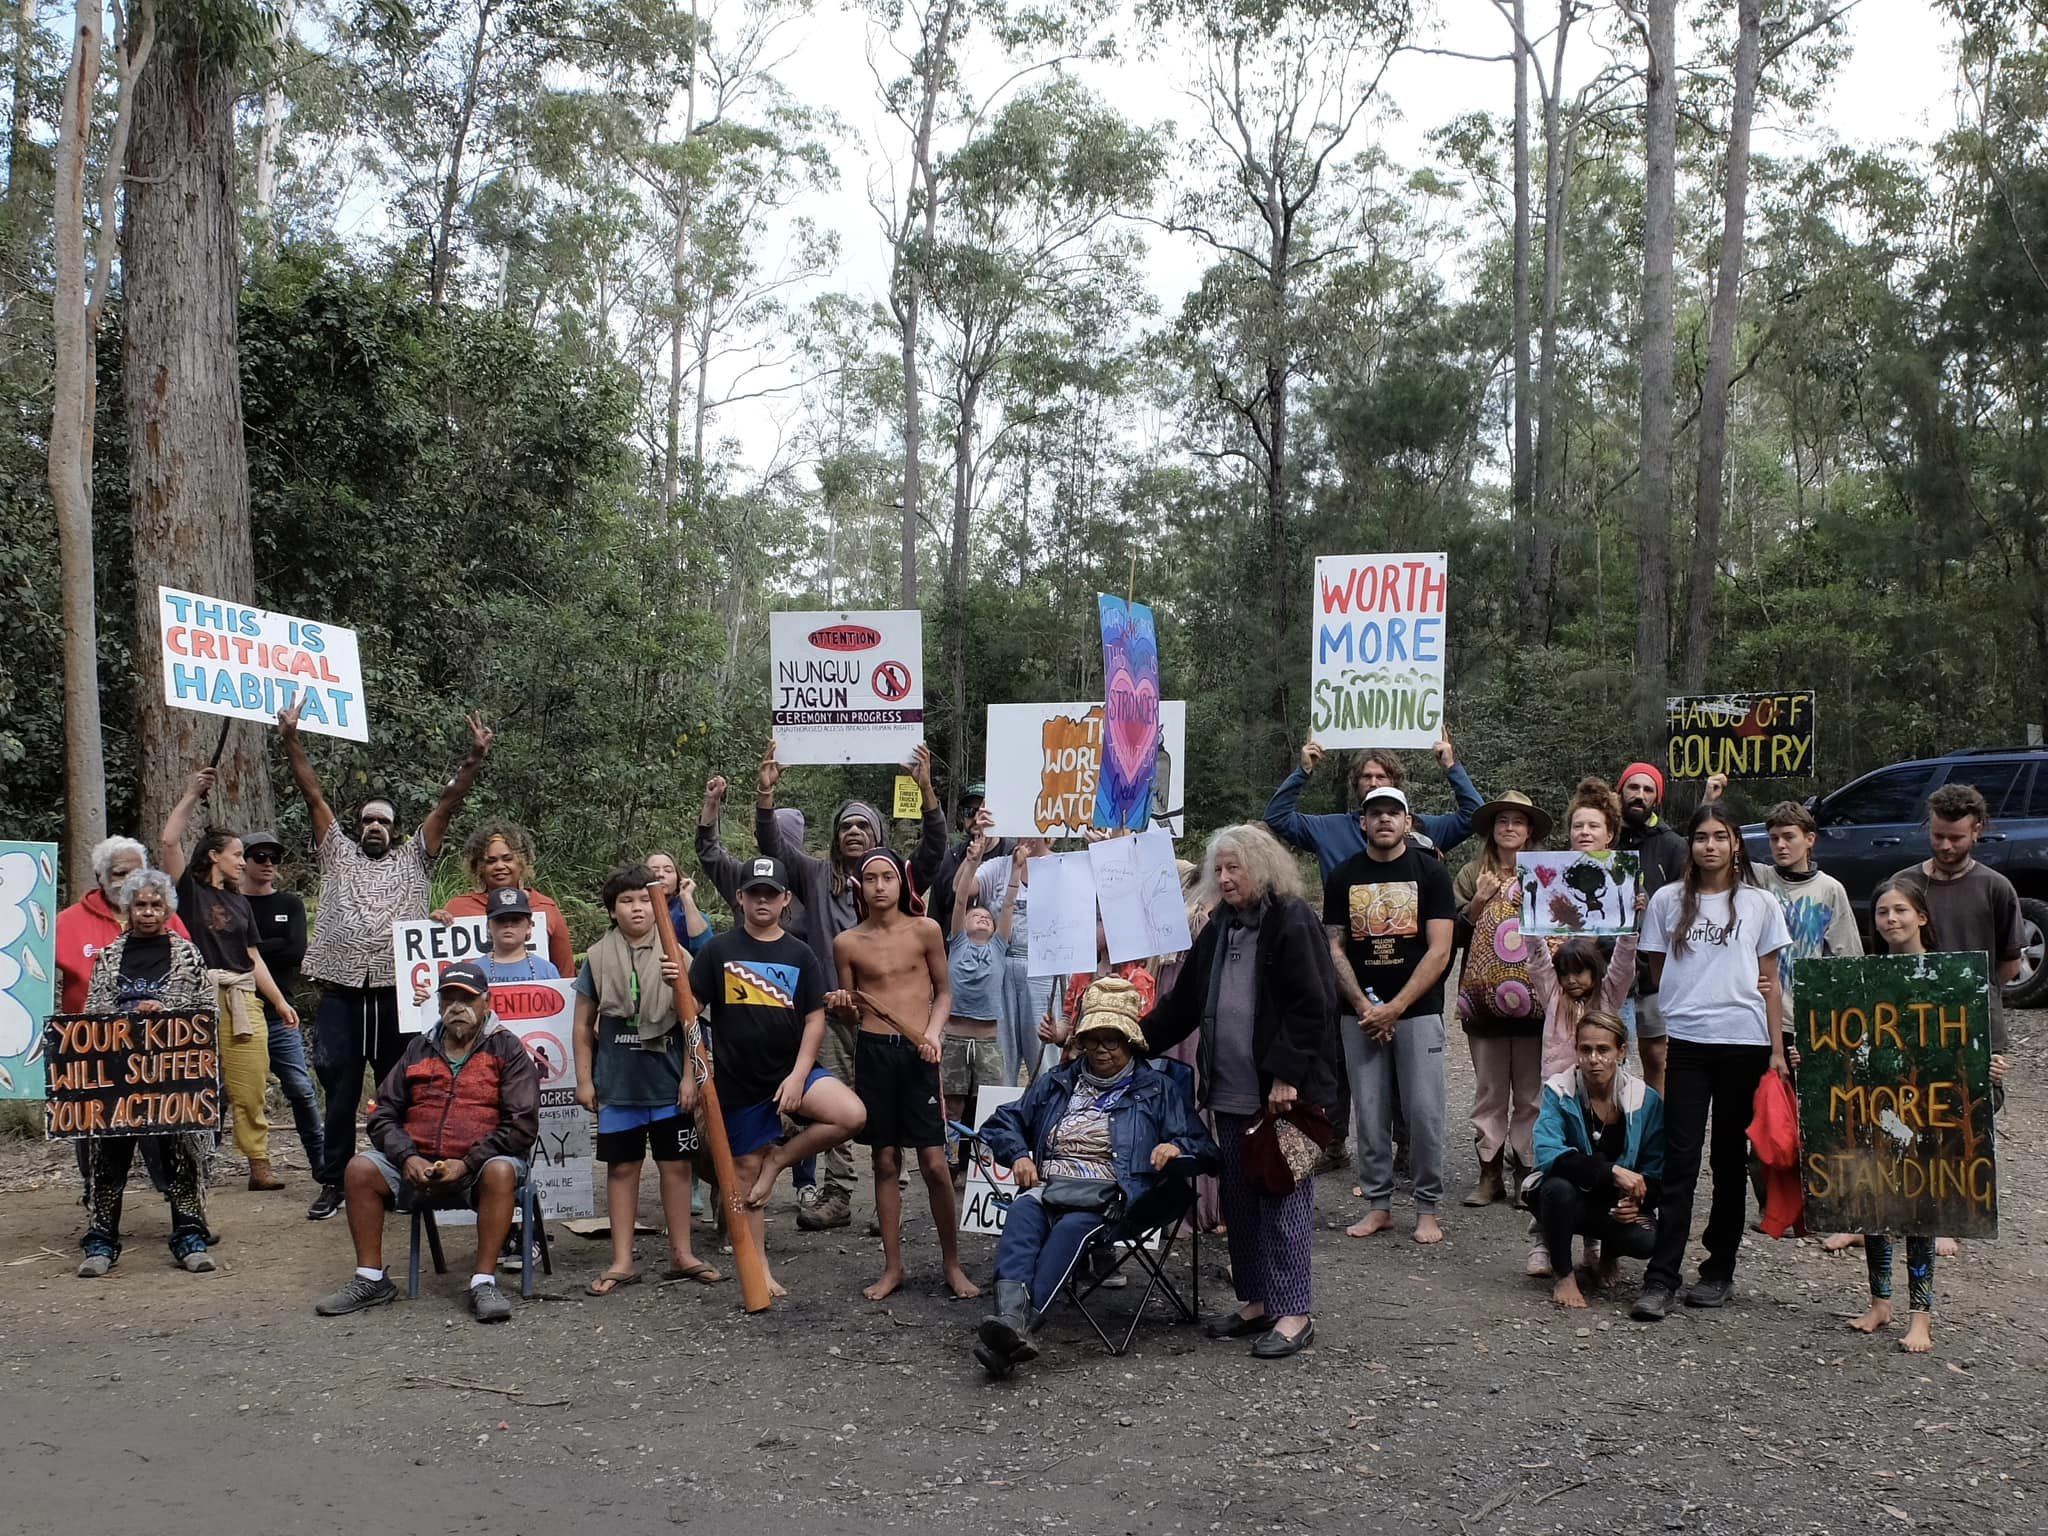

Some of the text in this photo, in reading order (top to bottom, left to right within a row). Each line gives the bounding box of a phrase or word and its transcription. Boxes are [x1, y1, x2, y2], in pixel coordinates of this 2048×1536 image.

[1320, 562, 1445, 613] WORTH
[166, 594, 325, 653] THIS IS
[811, 631, 876, 645] ATTENTION
[1319, 617, 1441, 665] MORE
[167, 626, 340, 683] CRITICAL
[779, 660, 860, 686] NUNGUU
[173, 663, 353, 727] HABITAT
[780, 687, 848, 709] JAGUN
[1312, 679, 1441, 732] STANDING
[1671, 696, 1809, 730] HANDS OFF
[776, 710, 902, 724] CEREMONY IN PROGRESS
[1045, 746, 1101, 774] WORL
[1669, 734, 1811, 778] COUNTRY
[1075, 771, 1095, 793] IS
[405, 924, 537, 961] REDU
[494, 991, 556, 1014] ENTION
[51, 1014, 211, 1055] YOUR KIDS
[1809, 1002, 1968, 1051] WORTH
[49, 1050, 217, 1092] WILL SUFFER
[46, 1088, 217, 1132] YOUR ACTIONS
[540, 1090, 575, 1106] OGRES
[1829, 1081, 1957, 1128] MORE
[1808, 1153, 1994, 1211] STANDING
